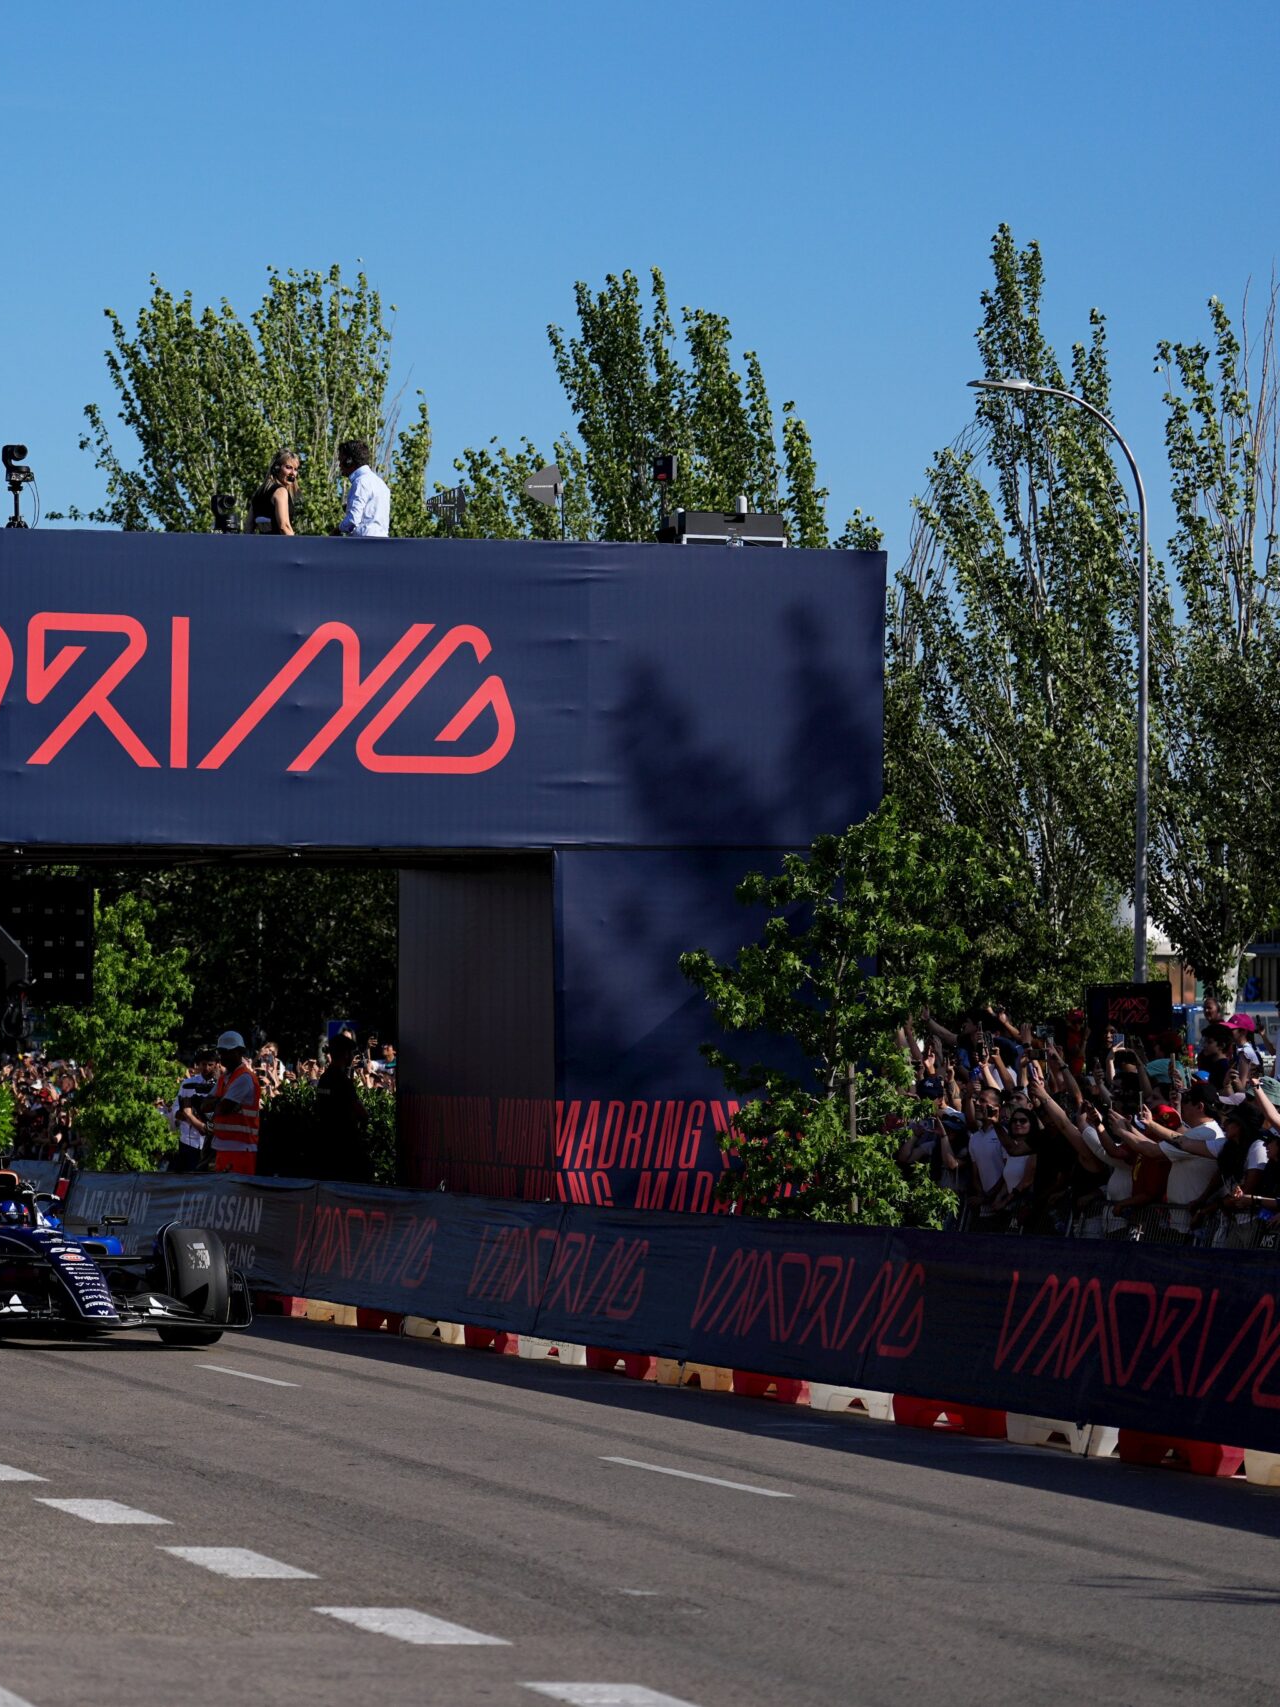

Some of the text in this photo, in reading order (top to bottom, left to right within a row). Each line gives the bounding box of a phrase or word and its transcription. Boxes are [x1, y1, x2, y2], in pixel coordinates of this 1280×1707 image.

[556, 1100, 706, 1170] MADRING
[184, 1192, 264, 1233] ATLASSIAN
[466, 1225, 650, 1321] MADRING
[690, 1246, 926, 1358] MADRING
